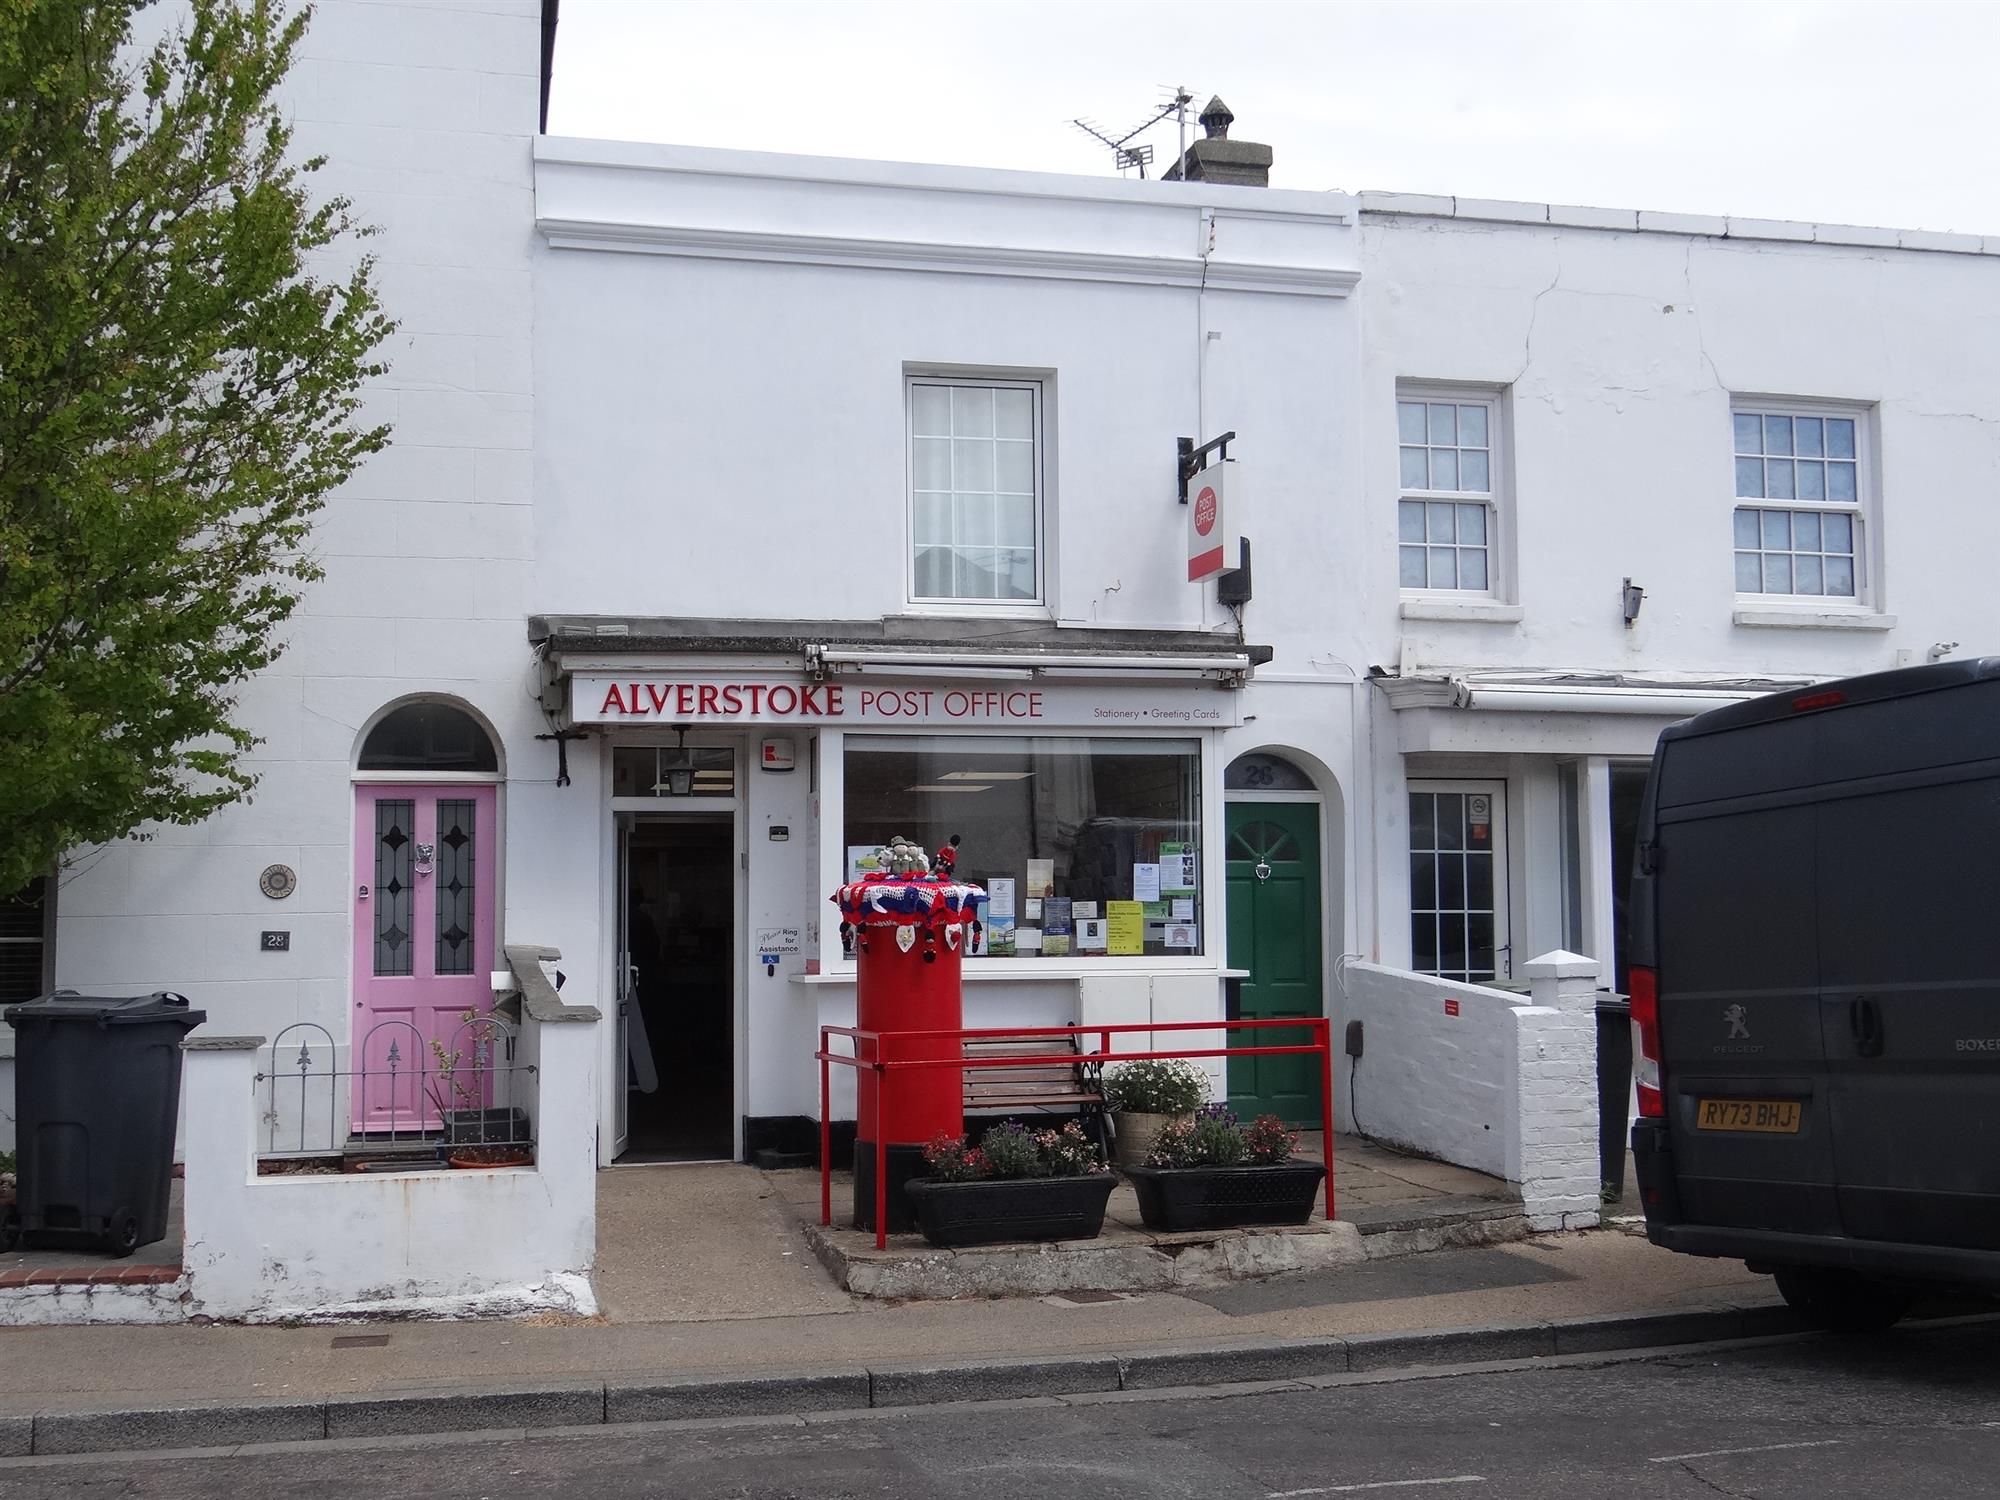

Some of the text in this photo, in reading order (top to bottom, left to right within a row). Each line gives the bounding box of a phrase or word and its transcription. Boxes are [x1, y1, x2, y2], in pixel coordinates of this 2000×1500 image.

[1199, 495, 1212, 511] POST
[1196, 508, 1215, 526] OFFICE
[600, 683, 1043, 717] ALVERSTOKE POST OFFICE
[1094, 708, 1220, 721] Stationery Greeting Cards
[267, 934, 284, 947] 28
[1713, 1045, 1765, 1054] PEUGEOT
[1706, 1103, 1793, 1127] RY73 BHJ
